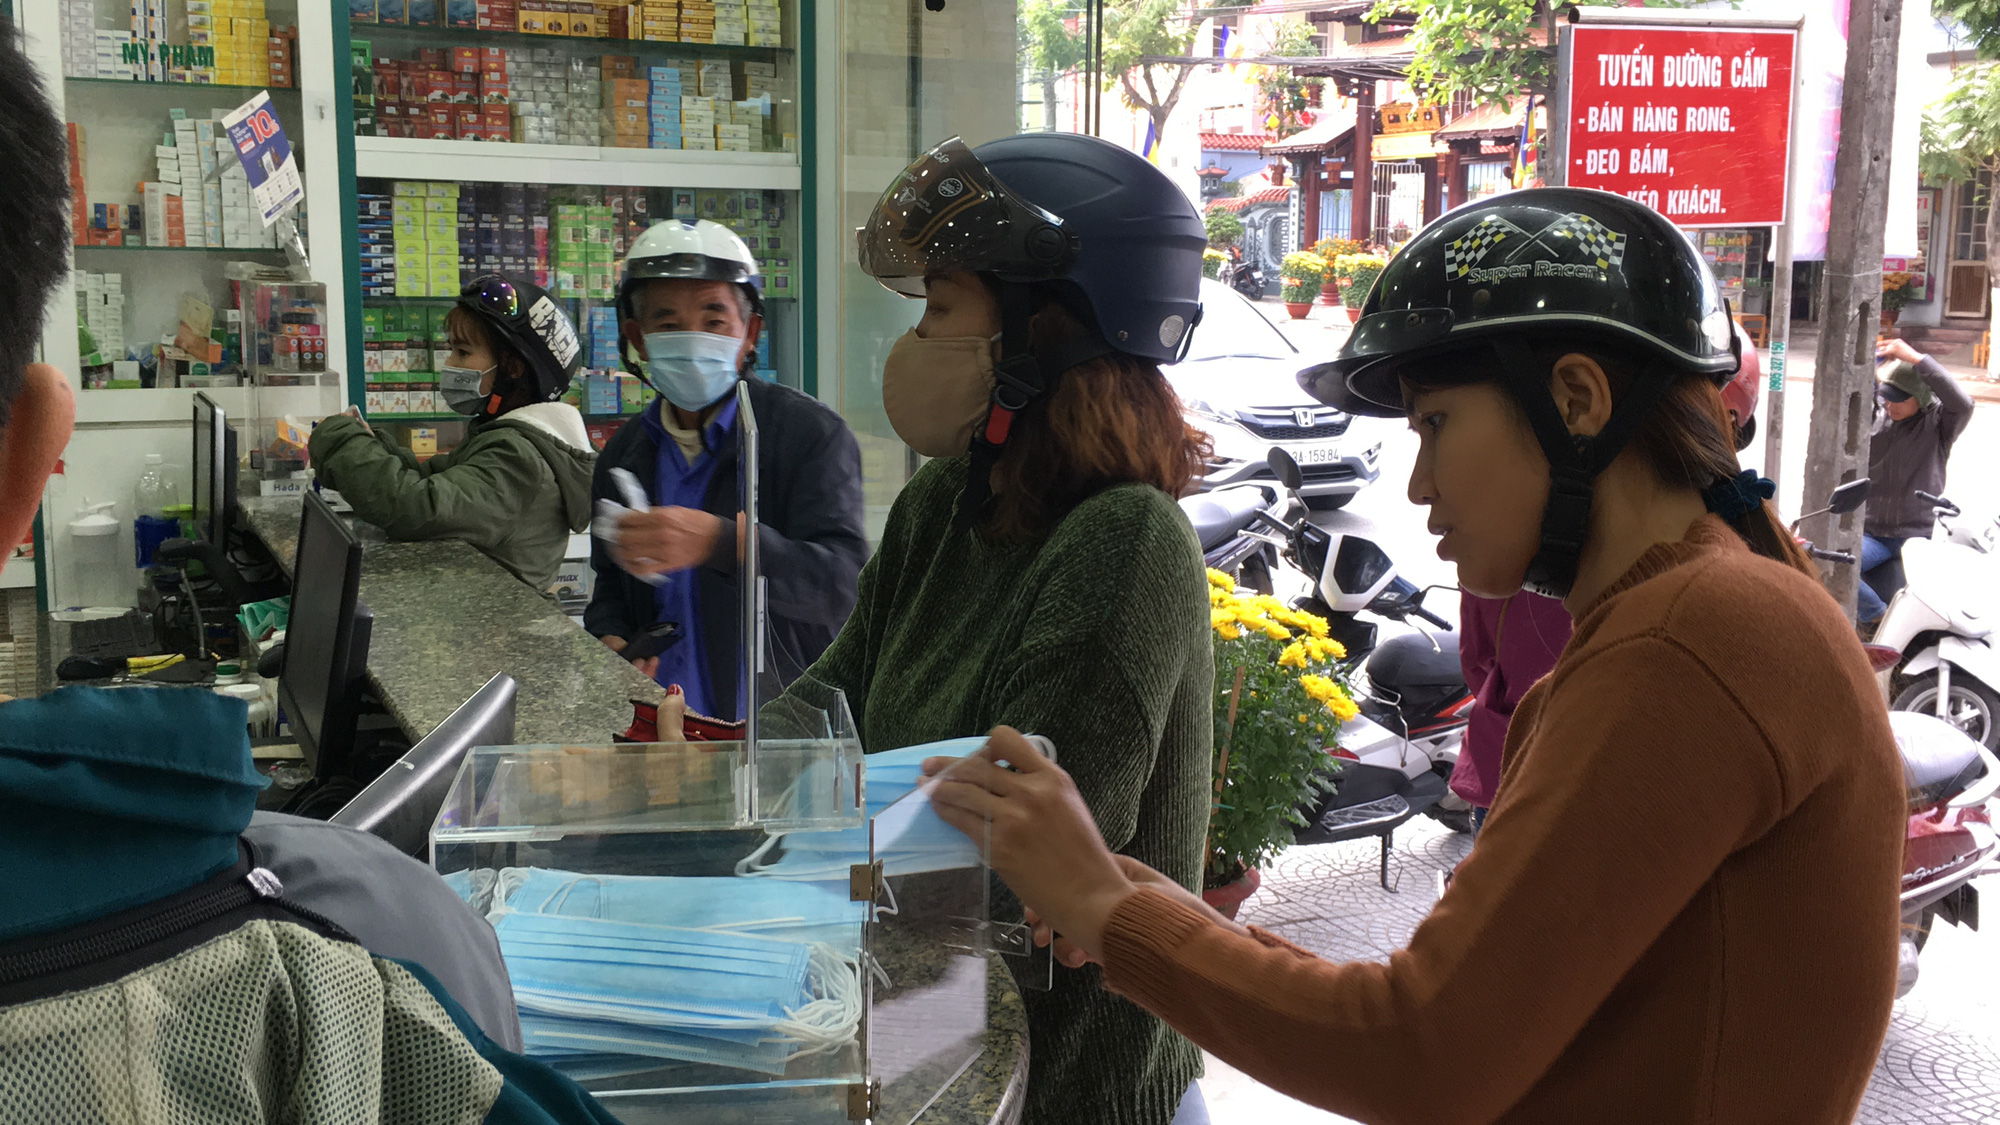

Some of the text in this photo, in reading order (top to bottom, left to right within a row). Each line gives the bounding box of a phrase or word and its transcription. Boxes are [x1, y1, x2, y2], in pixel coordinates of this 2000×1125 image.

[1598, 44, 1768, 88] TUYẾN ĐƯỜNG CẤM
[1632, 102, 1678, 132] HÀNG
[1685, 106, 1735, 132] RONG.
[1629, 143, 1674, 177] BÁM,
[1667, 184, 1727, 214] KHÁCH.
[1468, 263, 1532, 285] Super
[1291, 448, 1339, 464] 3A-159.84
[273, 483, 300, 492] Hada
